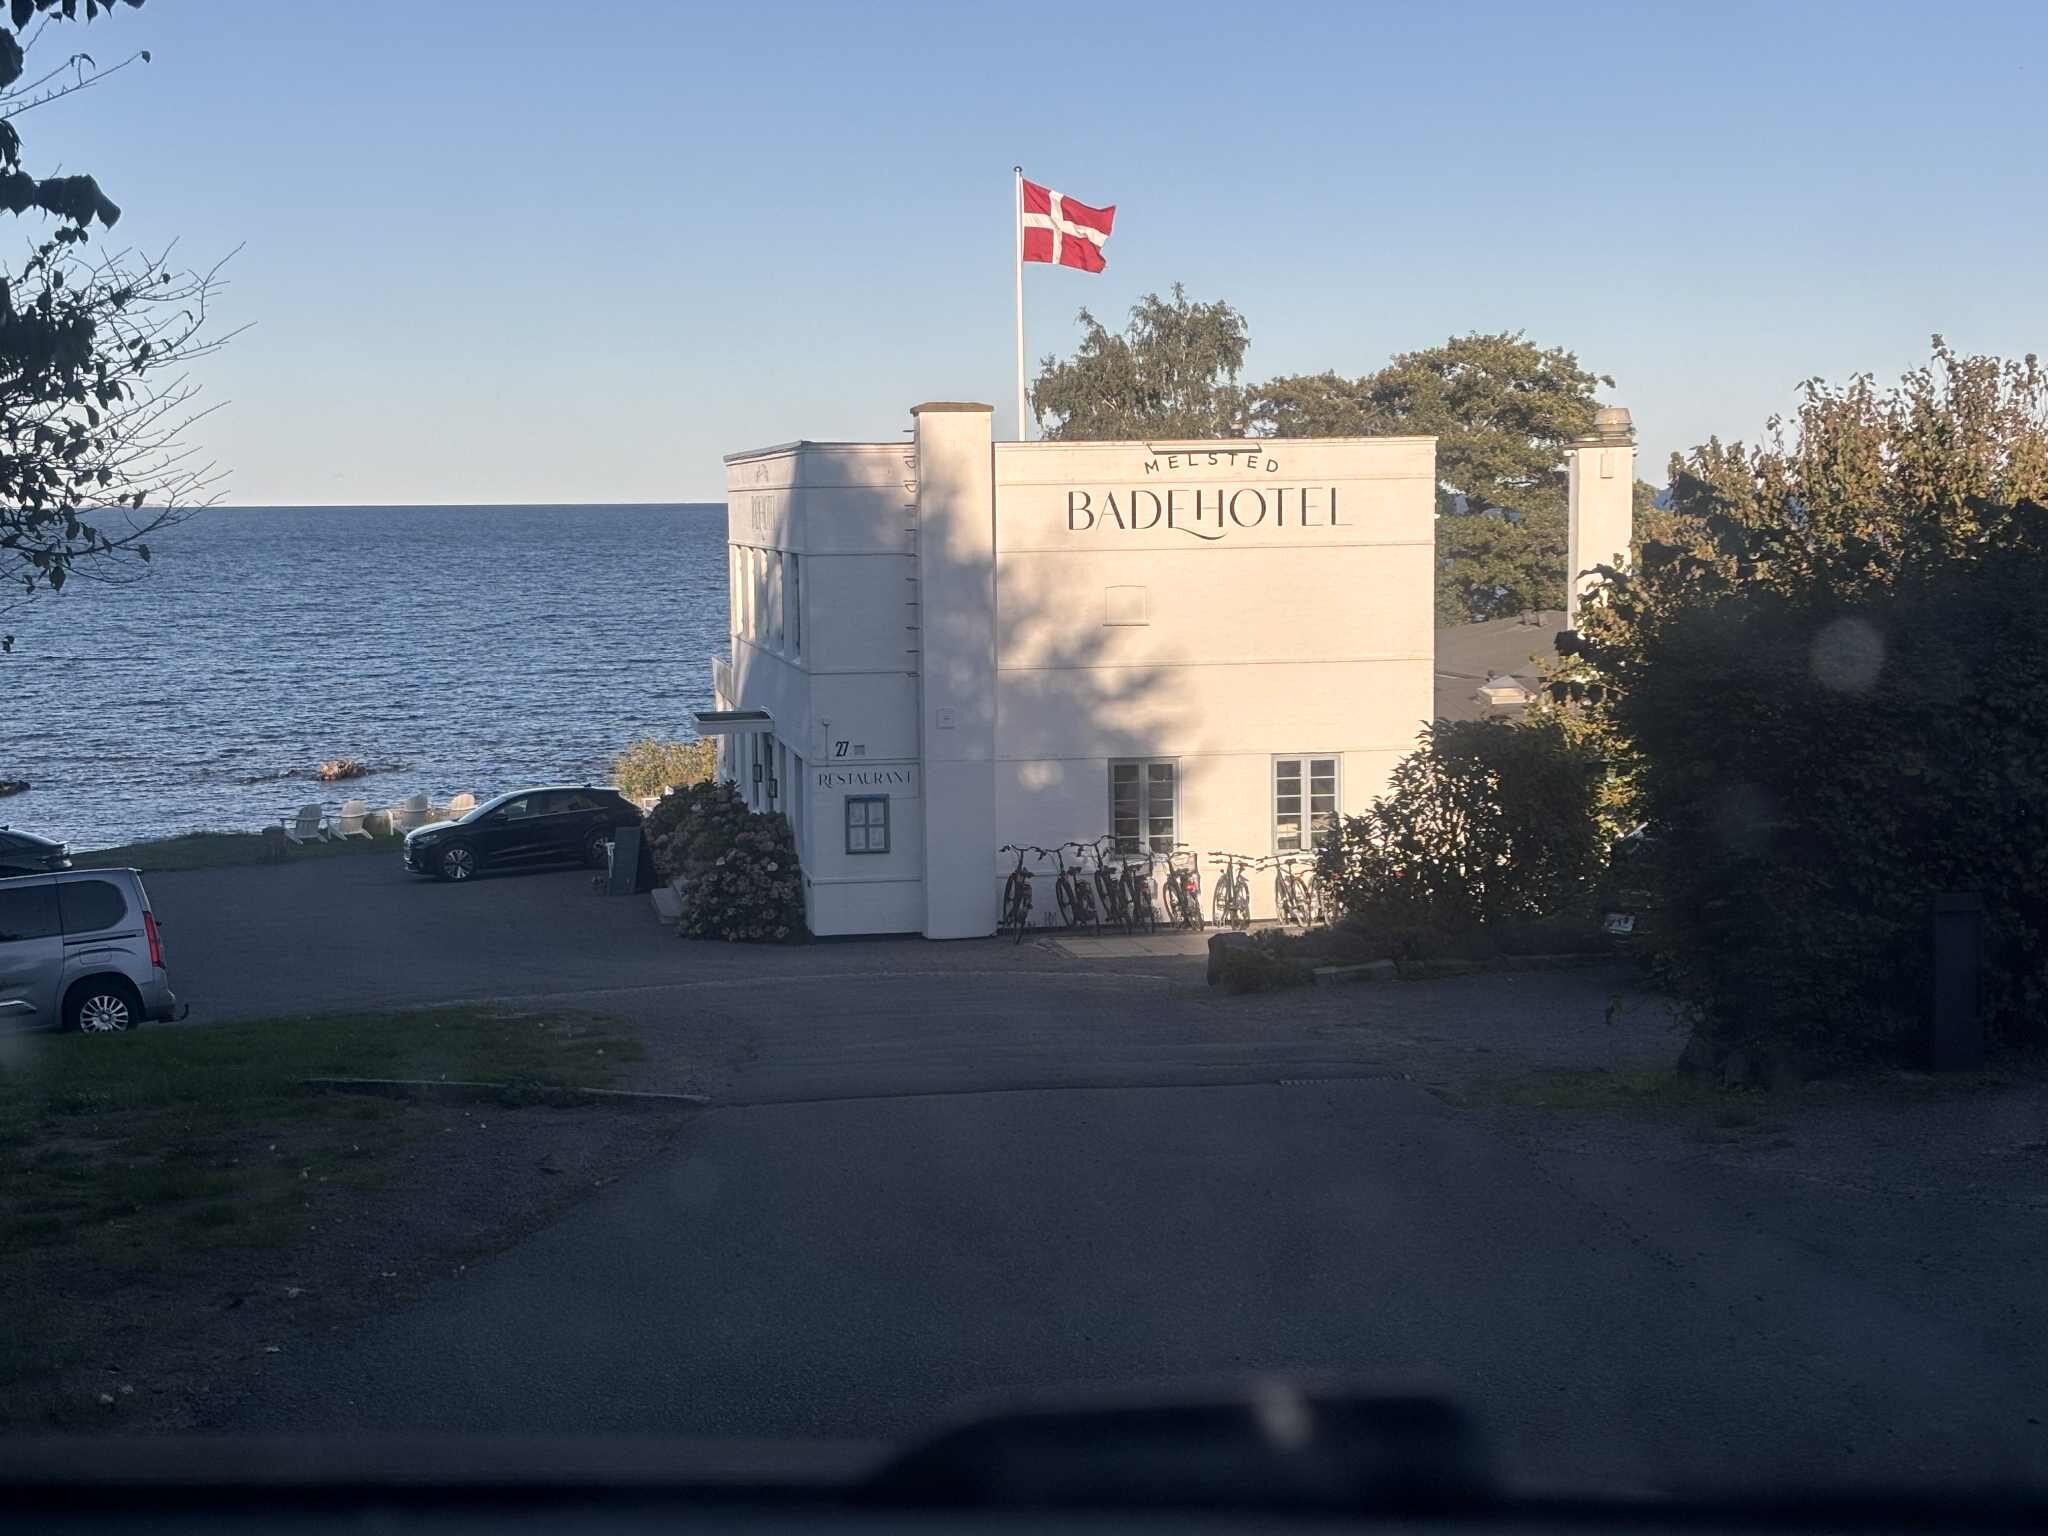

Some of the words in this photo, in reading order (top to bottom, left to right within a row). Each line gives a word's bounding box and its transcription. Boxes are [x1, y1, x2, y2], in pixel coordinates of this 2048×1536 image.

[1144, 452, 1279, 474] MELSTED
[1068, 487, 1353, 540] BADEHOTEL
[835, 741, 849, 757] 27
[818, 771, 912, 788] RESTAURANT
